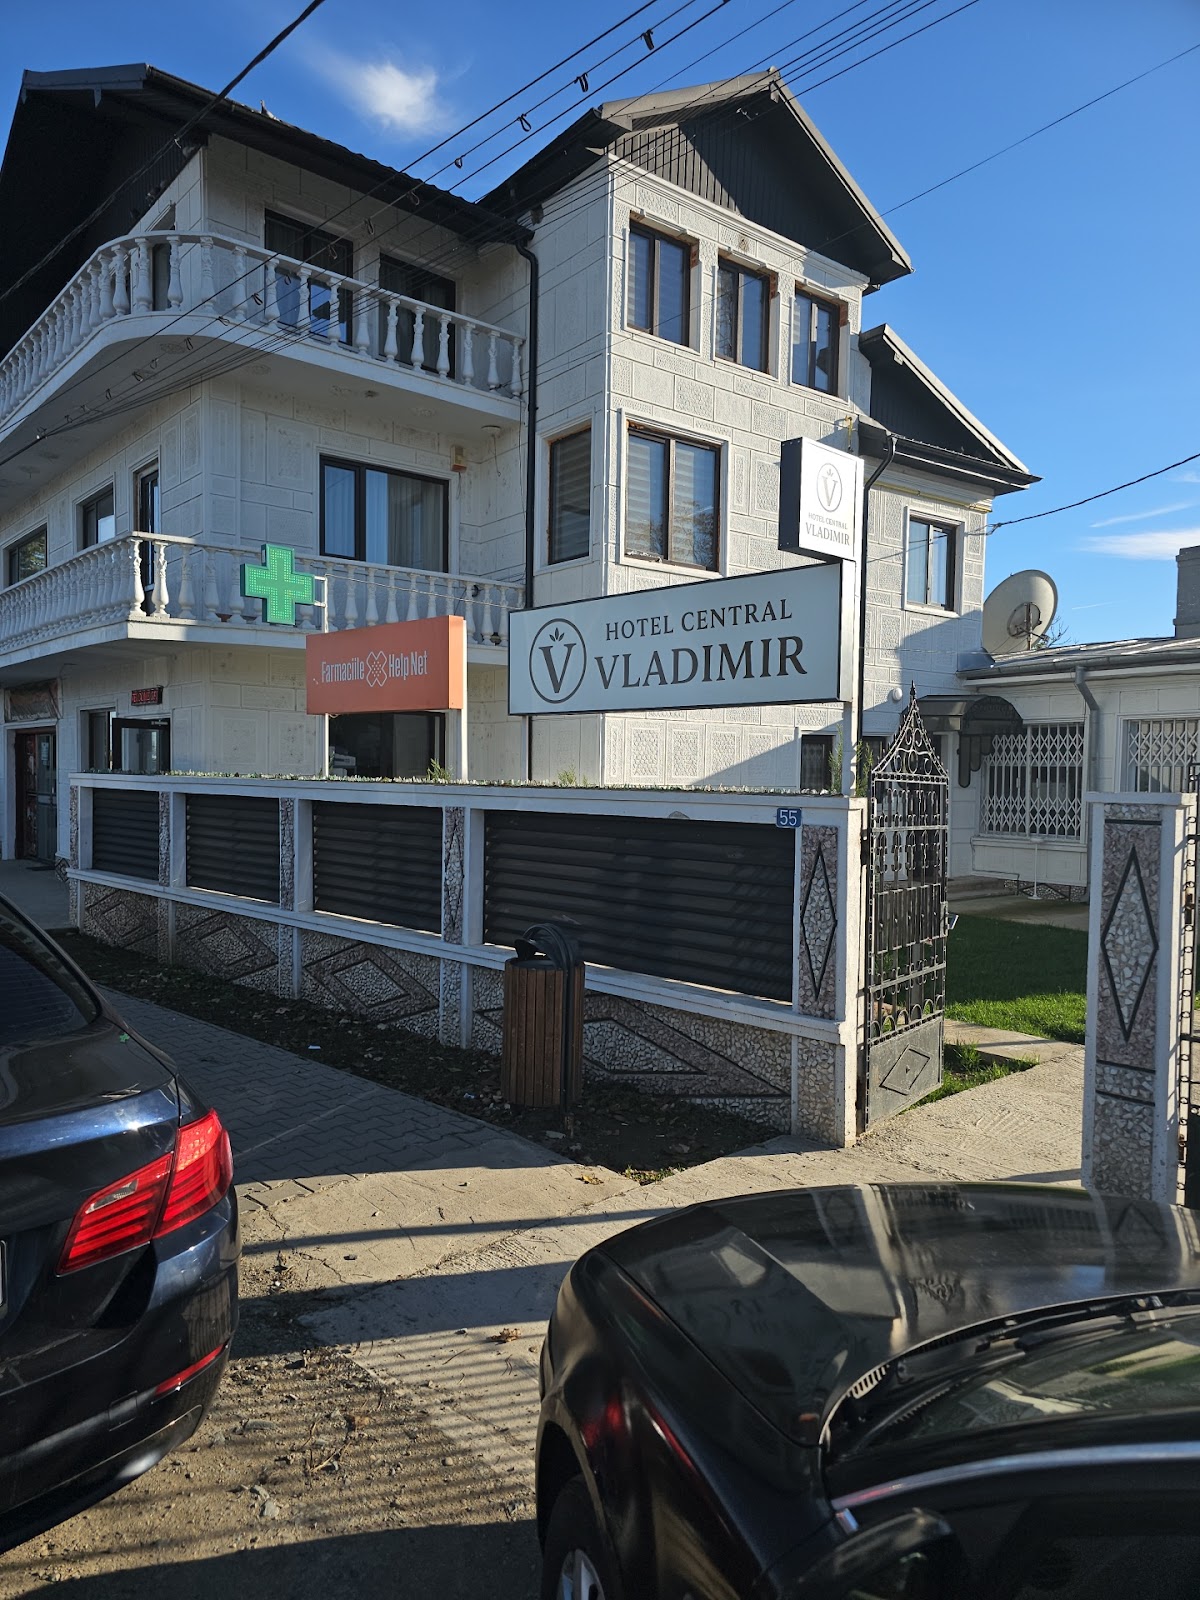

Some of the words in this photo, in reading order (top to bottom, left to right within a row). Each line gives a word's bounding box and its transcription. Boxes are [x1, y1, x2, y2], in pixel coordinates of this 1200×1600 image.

[821, 476, 838, 506] V
[805, 522, 850, 546] VLADIMIR
[808, 512, 825, 523] HOTEL
[826, 518, 848, 530] CENTRAL
[605, 615, 674, 641] HOTEL
[681, 599, 793, 631] CENTRAL
[321, 657, 365, 683] Farmaciile
[388, 654, 409, 680] Help
[410, 651, 428, 676] Net
[539, 643, 577, 693] V
[594, 635, 807, 690] VLADIMIR
[780, 809, 797, 826] 55
